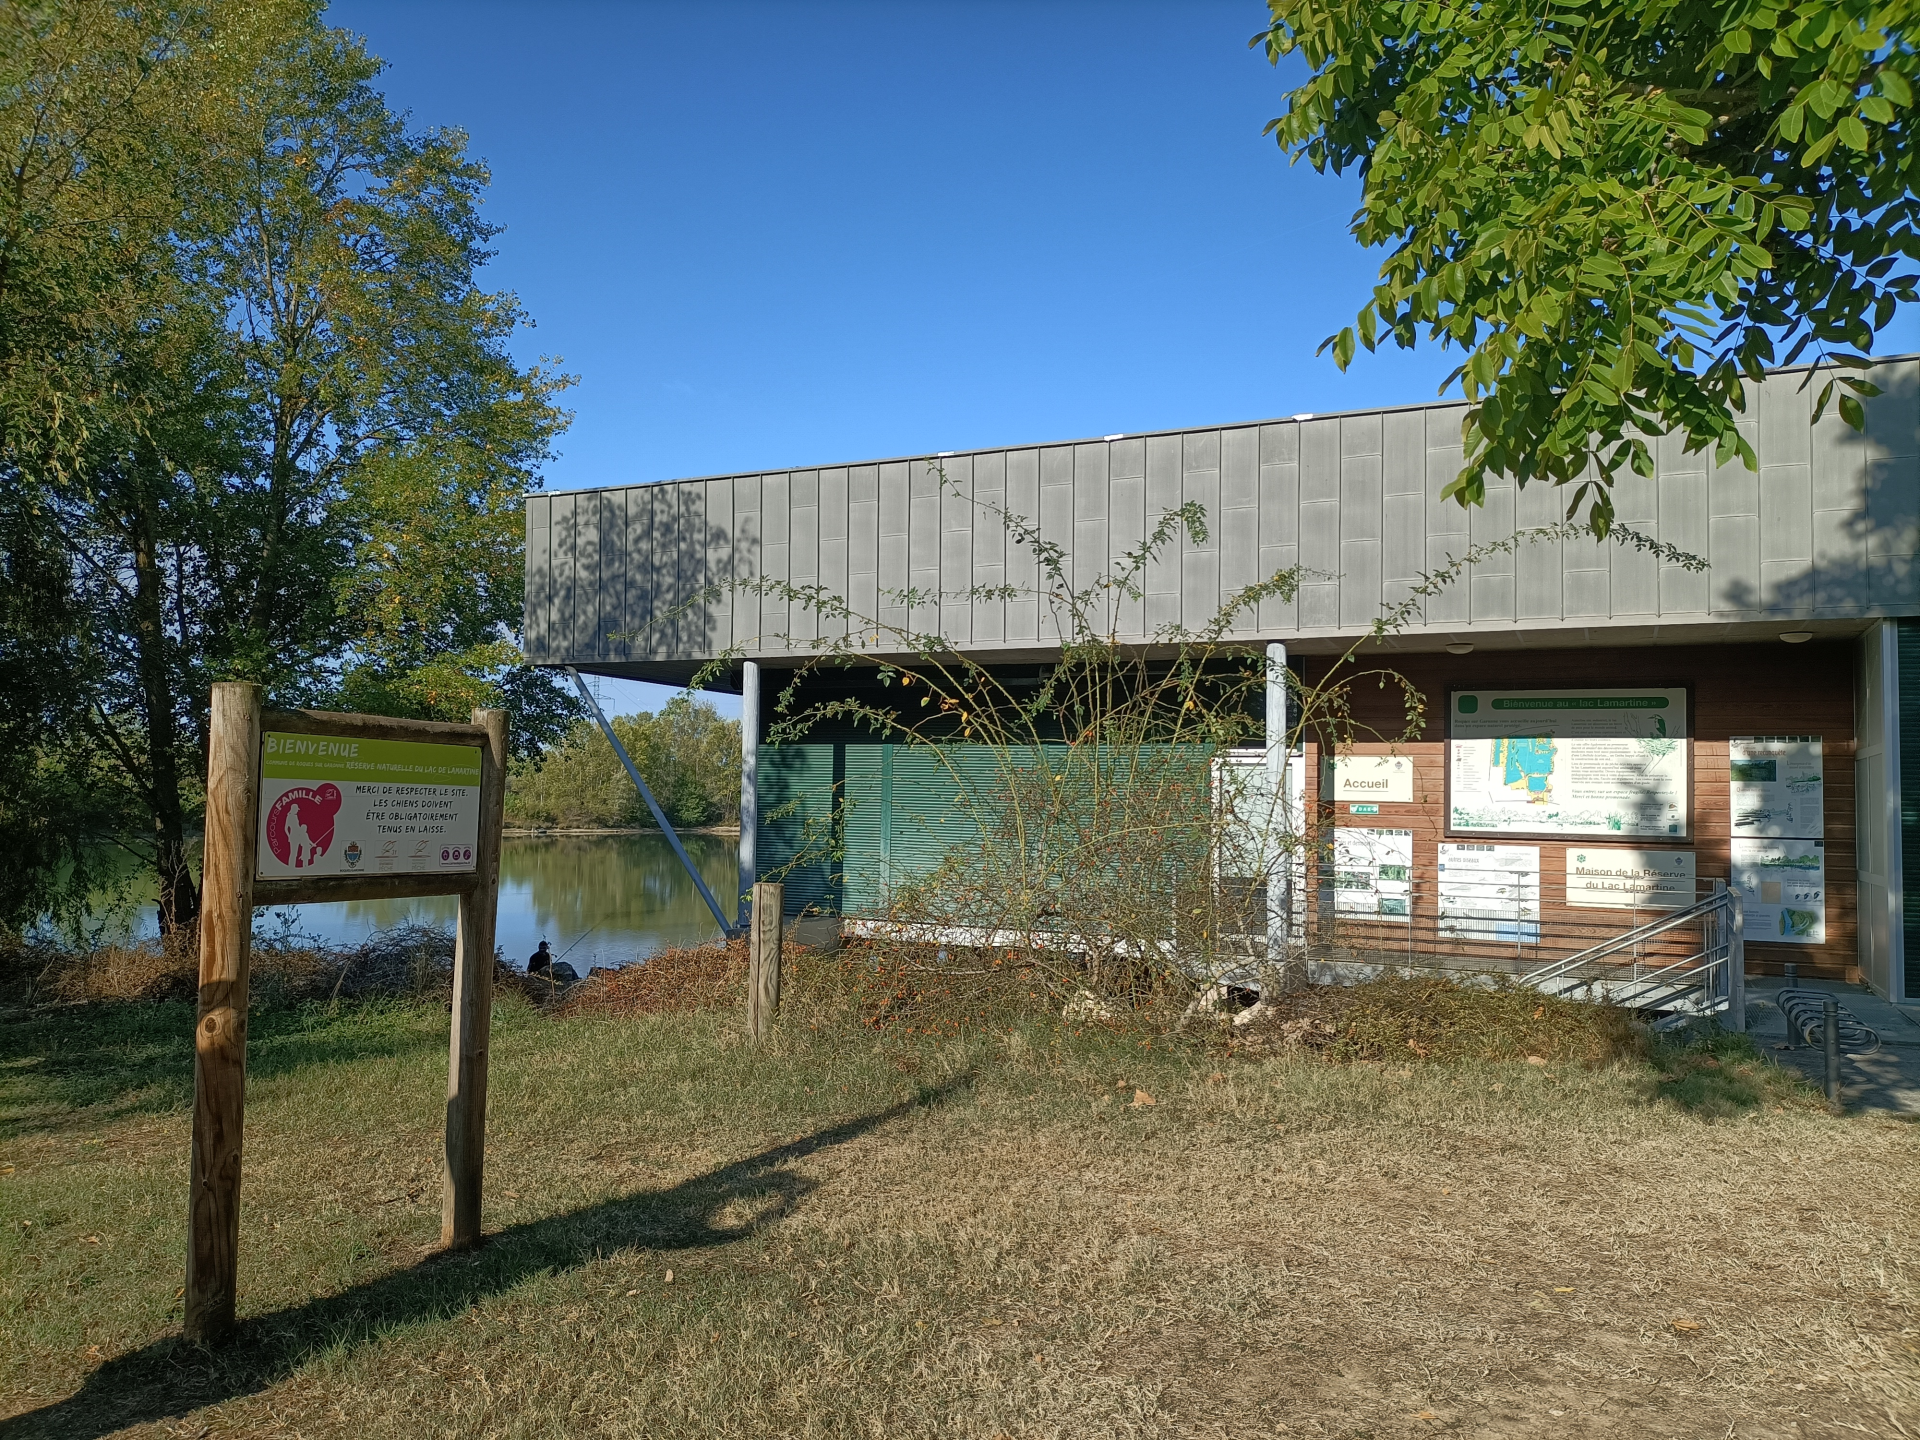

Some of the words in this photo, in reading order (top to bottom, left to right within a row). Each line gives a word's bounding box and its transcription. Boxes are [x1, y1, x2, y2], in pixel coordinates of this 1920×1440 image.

[1503, 699, 1554, 708] Bienvenue
[1579, 699, 1594, 707] lac
[1597, 698, 1648, 707] Lamartine
[266, 737, 359, 758] BIENVENUE
[376, 763, 413, 773] NATURELLE
[415, 765, 423, 773] DU
[425, 766, 437, 774] LAC
[438, 766, 446, 774] DE
[448, 767, 480, 776] LAMARTINE
[1343, 778, 1389, 789] Accueil
[355, 785, 380, 795] MERCI
[382, 786, 393, 795] DE
[395, 787, 437, 797] RESPECTER
[440, 788, 449, 796] LE
[451, 789, 469, 797] SITE.
[373, 799, 388, 807] LES
[391, 800, 419, 808] CHIENS
[422, 800, 454, 809] DOIVENT
[388, 812, 458, 822] OBLIGATOIREMENT
[377, 824, 402, 834] TENUS
[405, 826, 416, 834] EN
[418, 825, 447, 834] LAISSE.
[1575, 866, 1612, 876] Maison
[1615, 868, 1628, 876] de
[1631, 868, 1640, 877] la
[1643, 868, 1686, 878] Réserve
[1586, 880, 1598, 889] du
[1602, 881, 1620, 890] Lac
[1623, 882, 1676, 891] Lamartine
